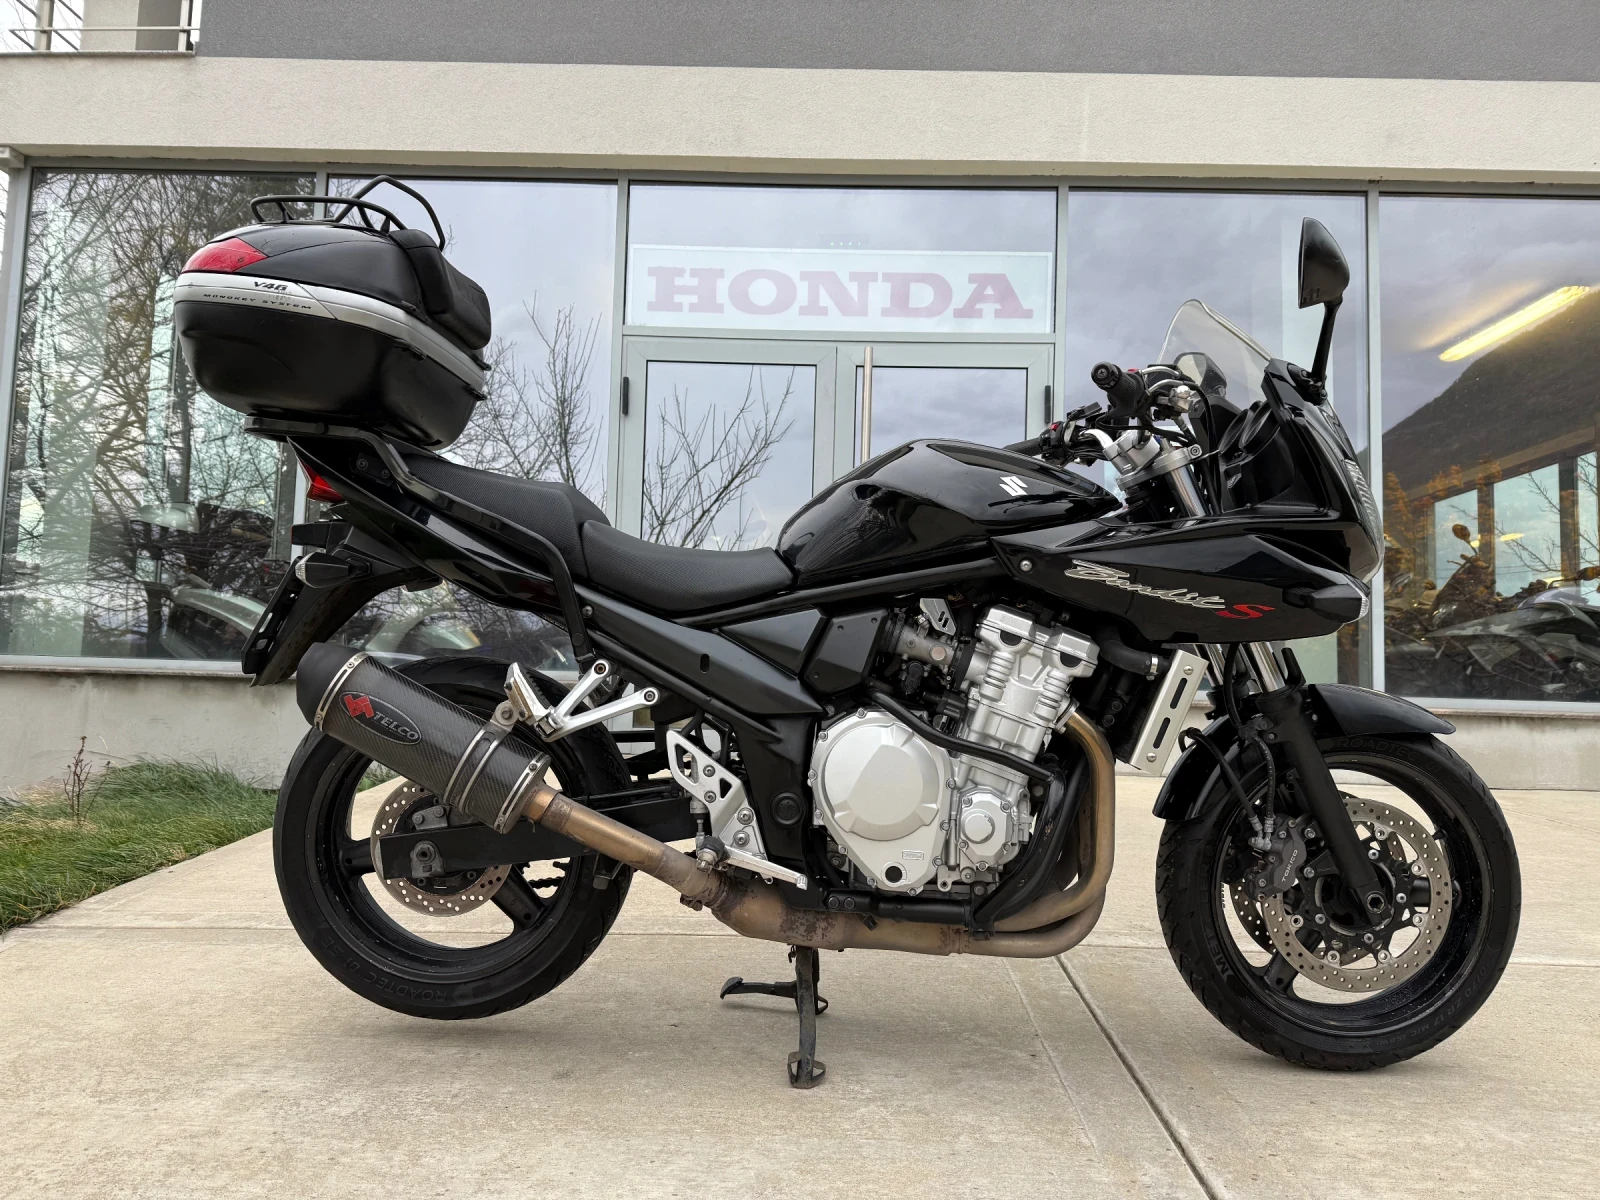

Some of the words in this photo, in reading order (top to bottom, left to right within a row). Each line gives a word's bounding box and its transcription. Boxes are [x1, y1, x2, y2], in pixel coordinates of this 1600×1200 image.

[202, 293, 257, 302] MONOKEY
[261, 299, 312, 309] SYSTEM
[646, 265, 1033, 319] HONDA
[1064, 559, 1226, 609] Bandit
[1215, 604, 1276, 620] S
[375, 711, 418, 739] TELCO
[1336, 738, 1422, 762] ROADTEC
[1281, 849, 1298, 883] TOKICO
[363, 971, 448, 1002] ROADTEC
